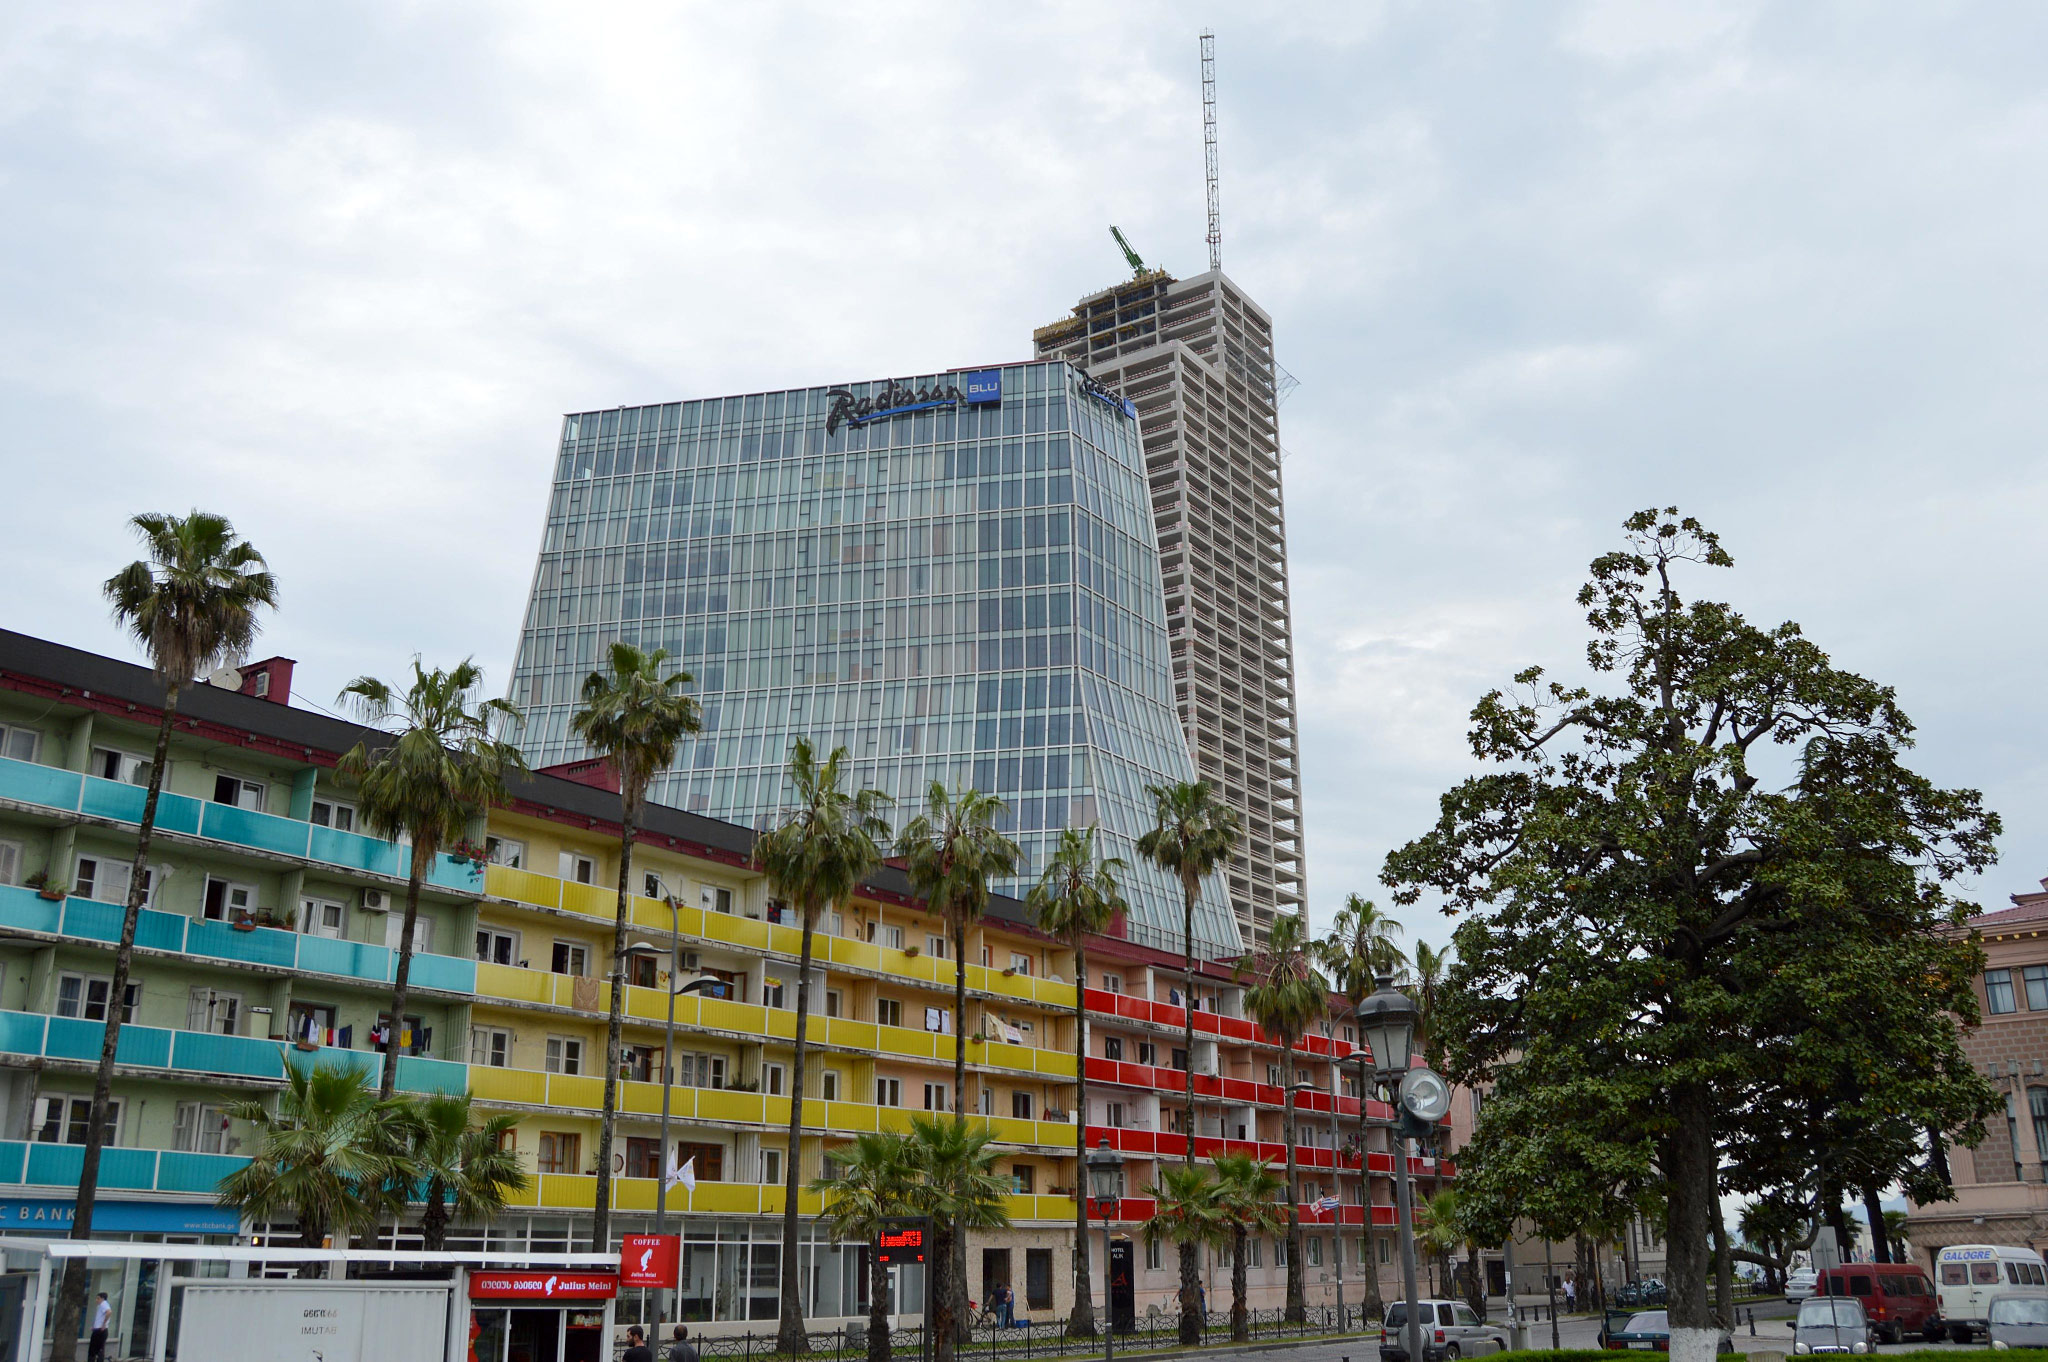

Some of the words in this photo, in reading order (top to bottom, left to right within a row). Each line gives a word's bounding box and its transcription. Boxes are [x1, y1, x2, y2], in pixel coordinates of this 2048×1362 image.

[826, 378, 968, 437] Radisson
[969, 382, 998, 393] BLU
[1943, 1250, 1991, 1261] GALOGRE
[559, 1282, 586, 1290] Julius
[588, 1282, 612, 1290] Meinl
